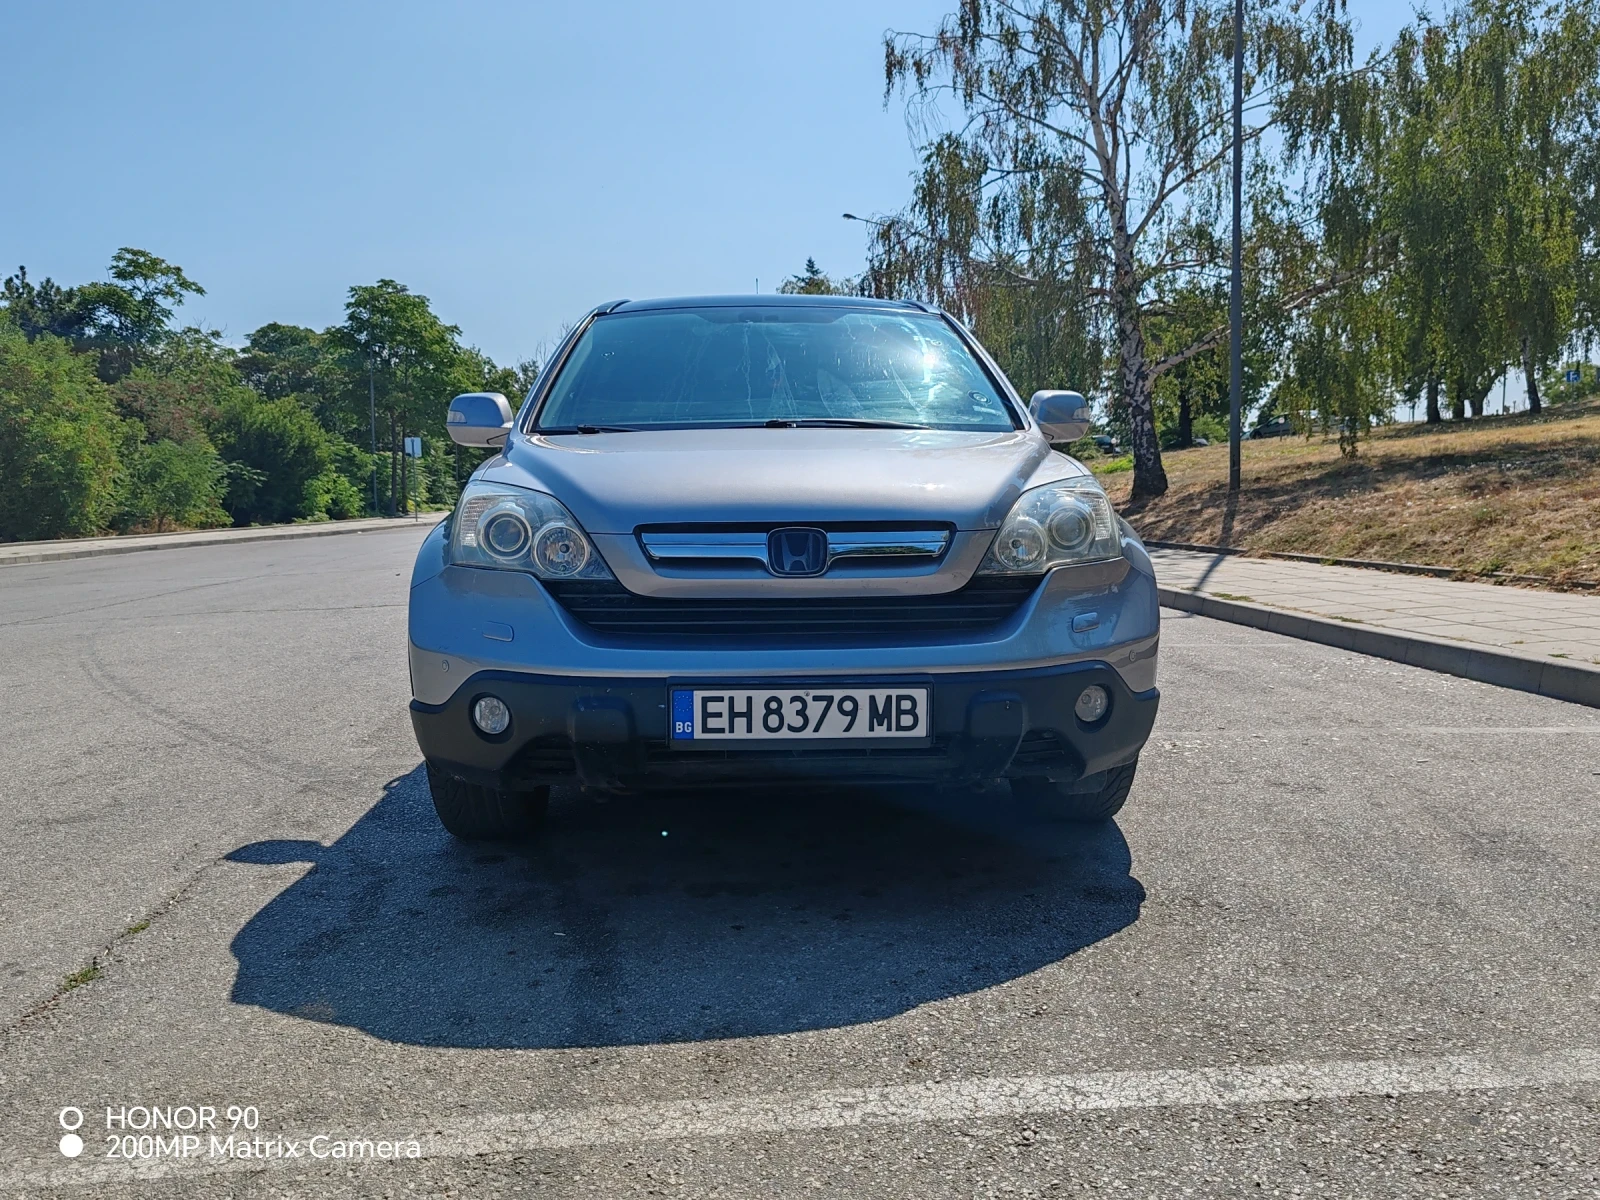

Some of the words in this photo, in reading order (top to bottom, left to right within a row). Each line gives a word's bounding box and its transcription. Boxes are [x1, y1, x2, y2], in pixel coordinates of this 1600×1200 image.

[675, 721, 692, 733] BG
[701, 695, 753, 734] EH
[762, 695, 859, 733] 8379
[868, 694, 919, 733] MB
